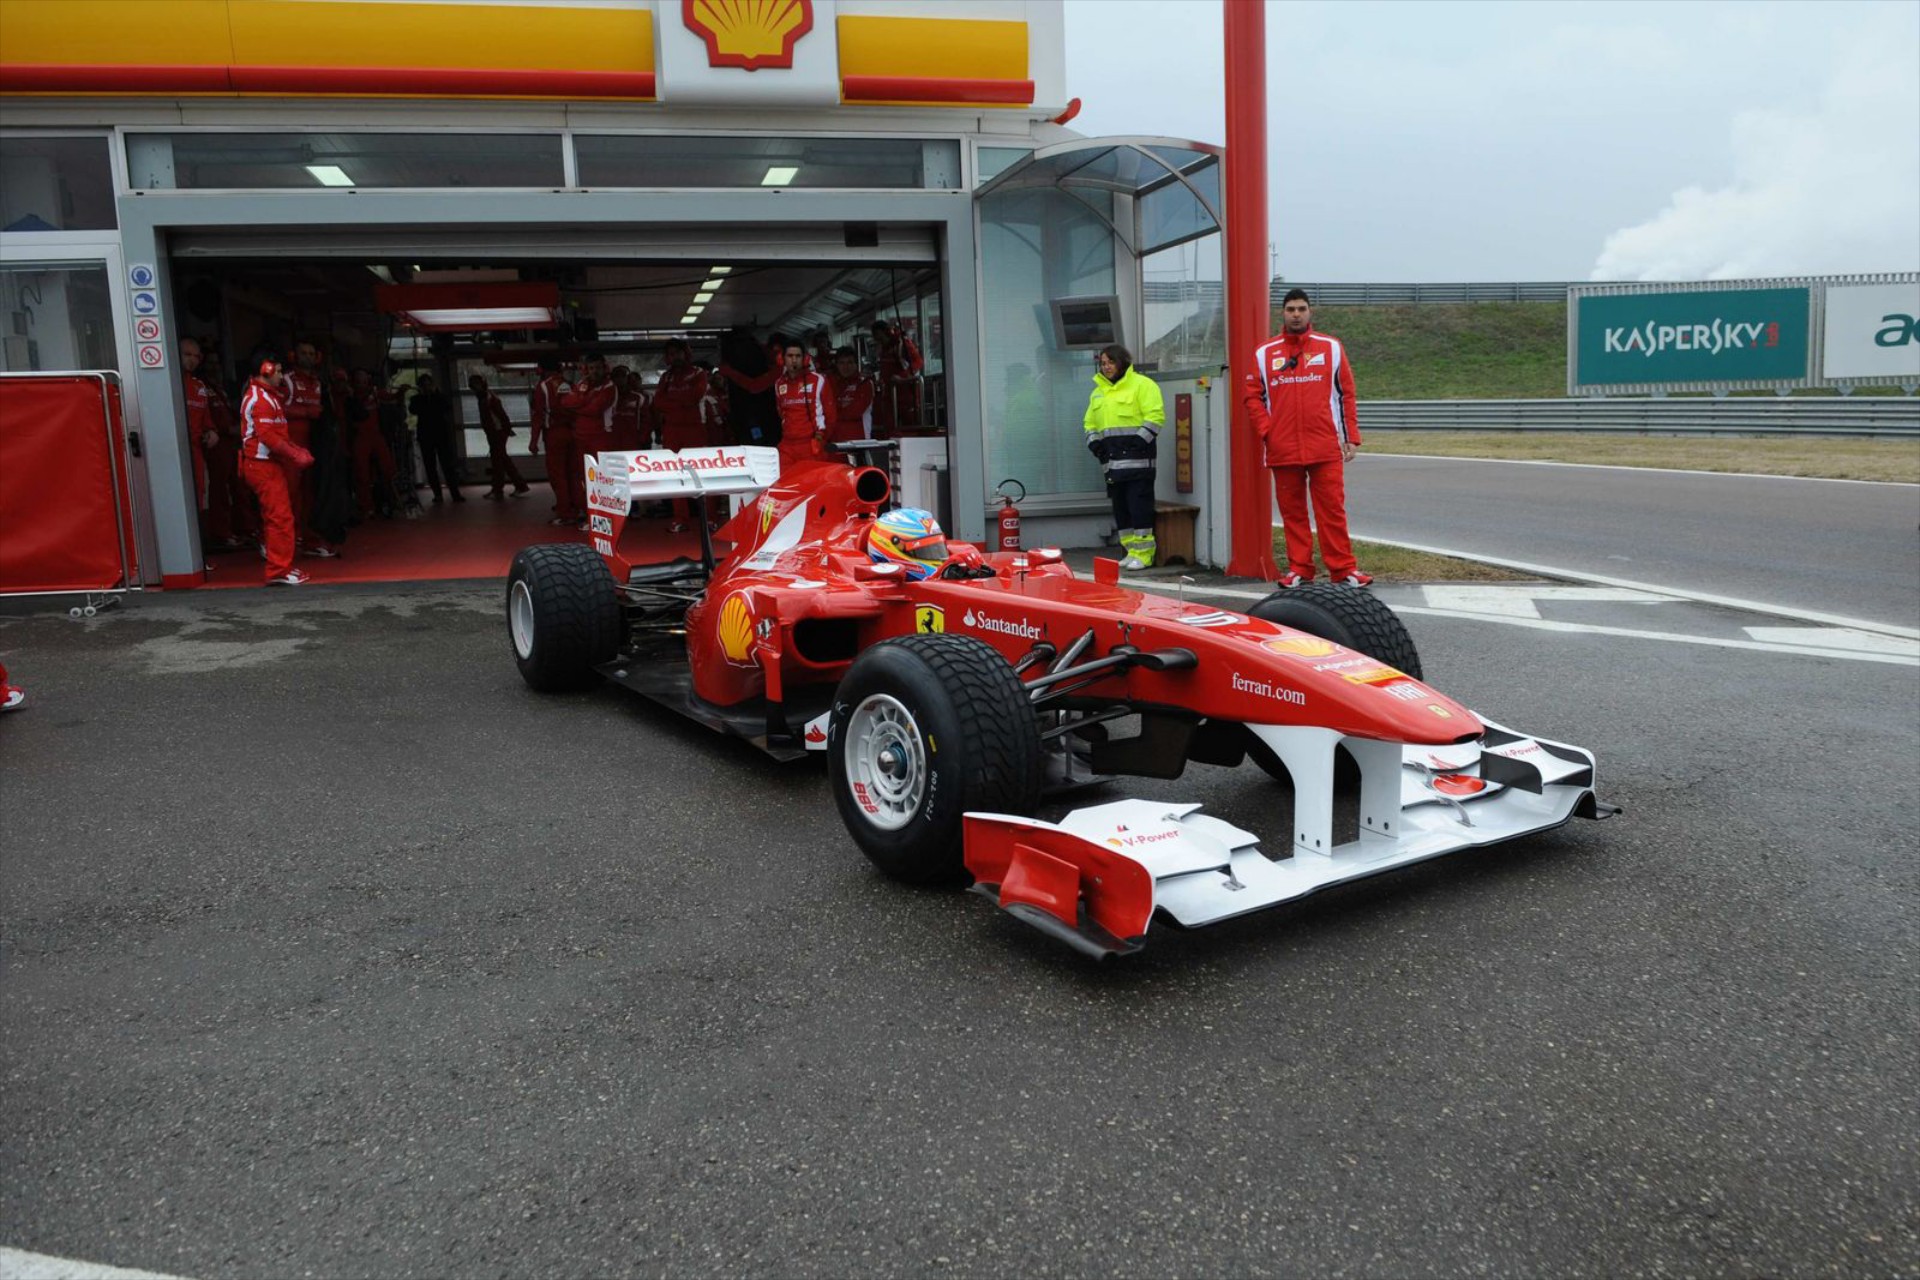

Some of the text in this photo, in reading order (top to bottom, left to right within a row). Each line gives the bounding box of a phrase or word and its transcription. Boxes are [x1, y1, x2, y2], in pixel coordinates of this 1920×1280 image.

[1605, 317, 1765, 358] KASPERSKY
[1278, 373, 1322, 384] Santander
[635, 449, 746, 473] Santander
[977, 611, 1041, 640] Santander
[1232, 672, 1306, 705] ferrari.com
[1123, 829, 1180, 847] V-Power
